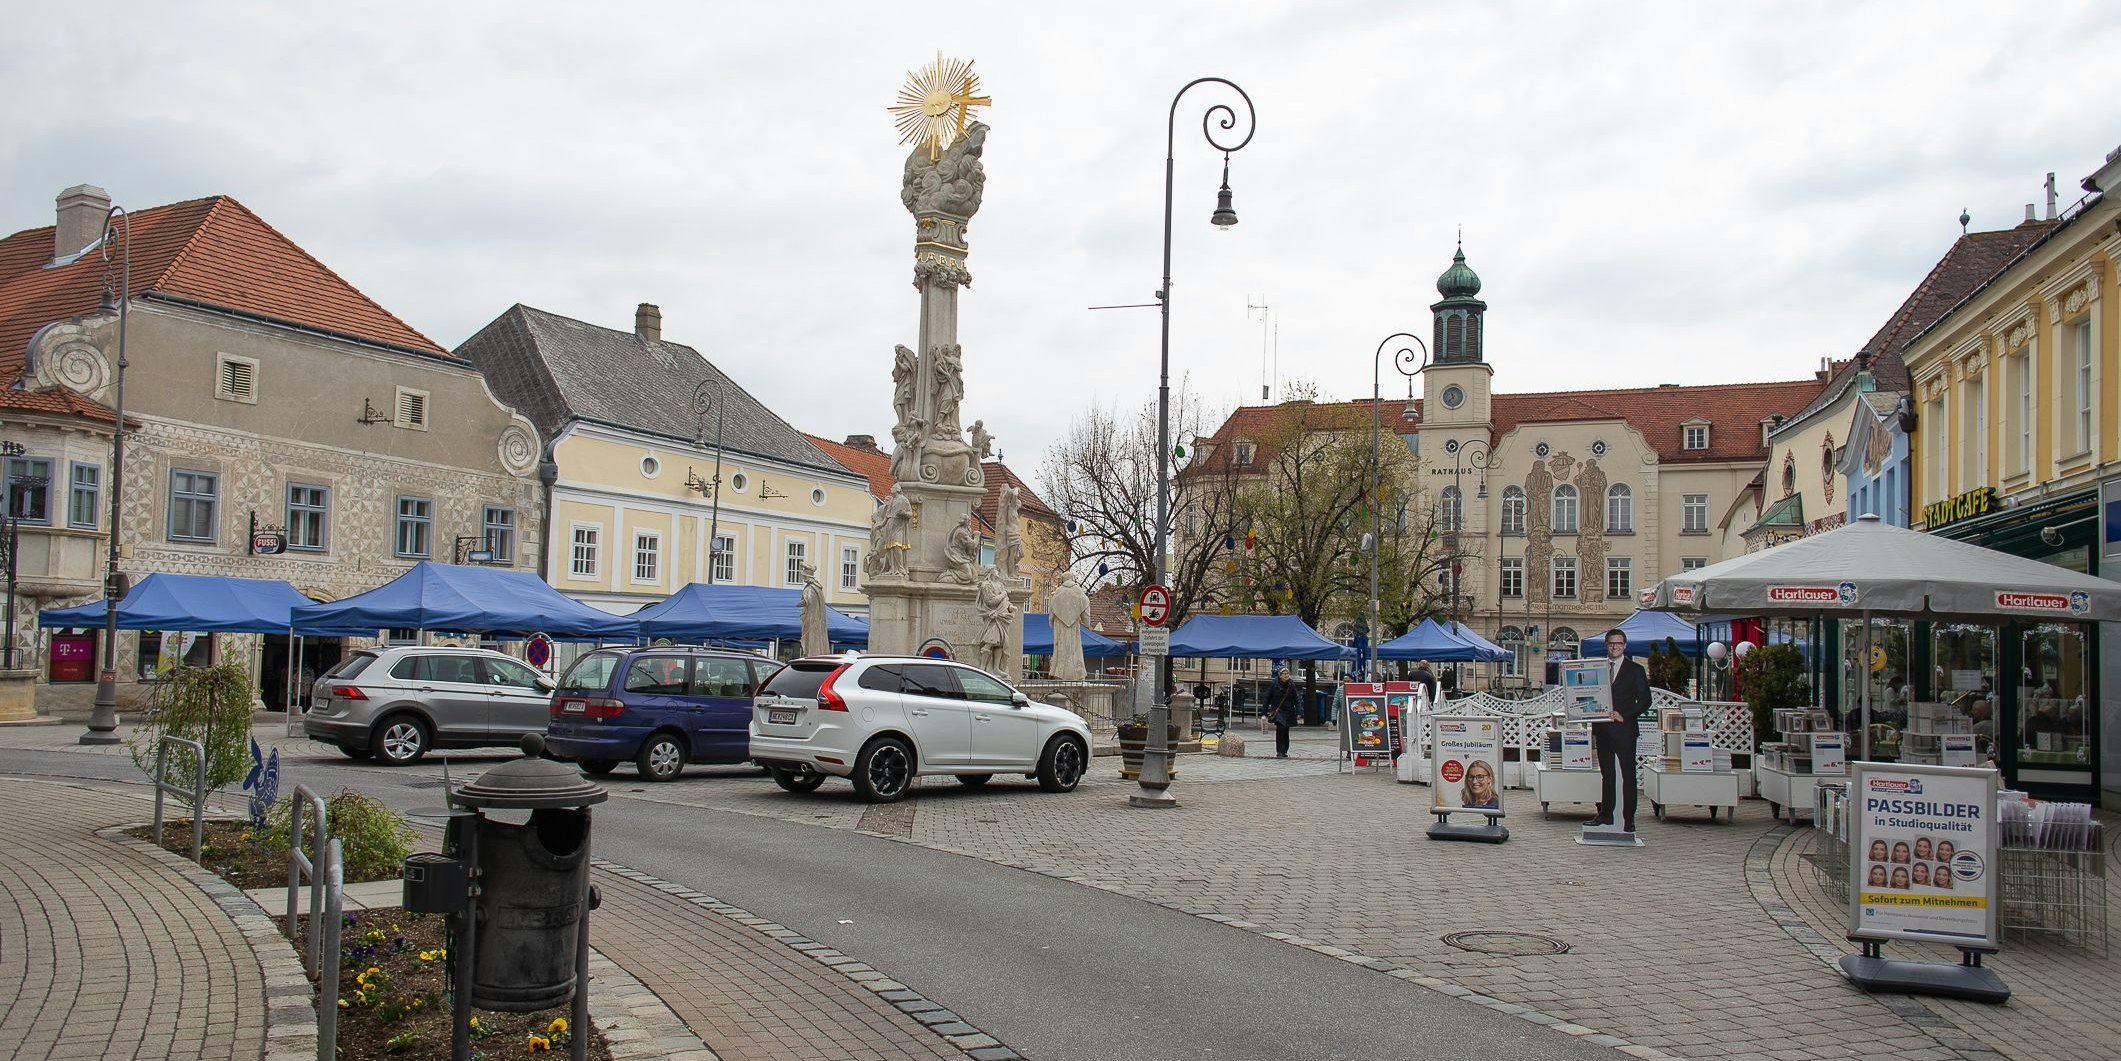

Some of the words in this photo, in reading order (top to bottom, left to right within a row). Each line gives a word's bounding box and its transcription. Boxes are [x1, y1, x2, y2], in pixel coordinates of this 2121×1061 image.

[1431, 467, 1472, 475] RATHAUS
[1775, 589, 1833, 600] Hartlauer
[2003, 594, 2063, 607] Hartlauer
[1464, 741, 1493, 749] Jubiläum
[1872, 780, 1907, 789] Hartlauer
[1867, 798, 1980, 819] PASSBILDER
[1875, 816, 1885, 826] in
[1889, 817, 1972, 832] Studioqualität
[1868, 895, 1897, 904] Sofort
[1900, 897, 1920, 905] zum
[1923, 897, 1978, 907] Mitnehmen
